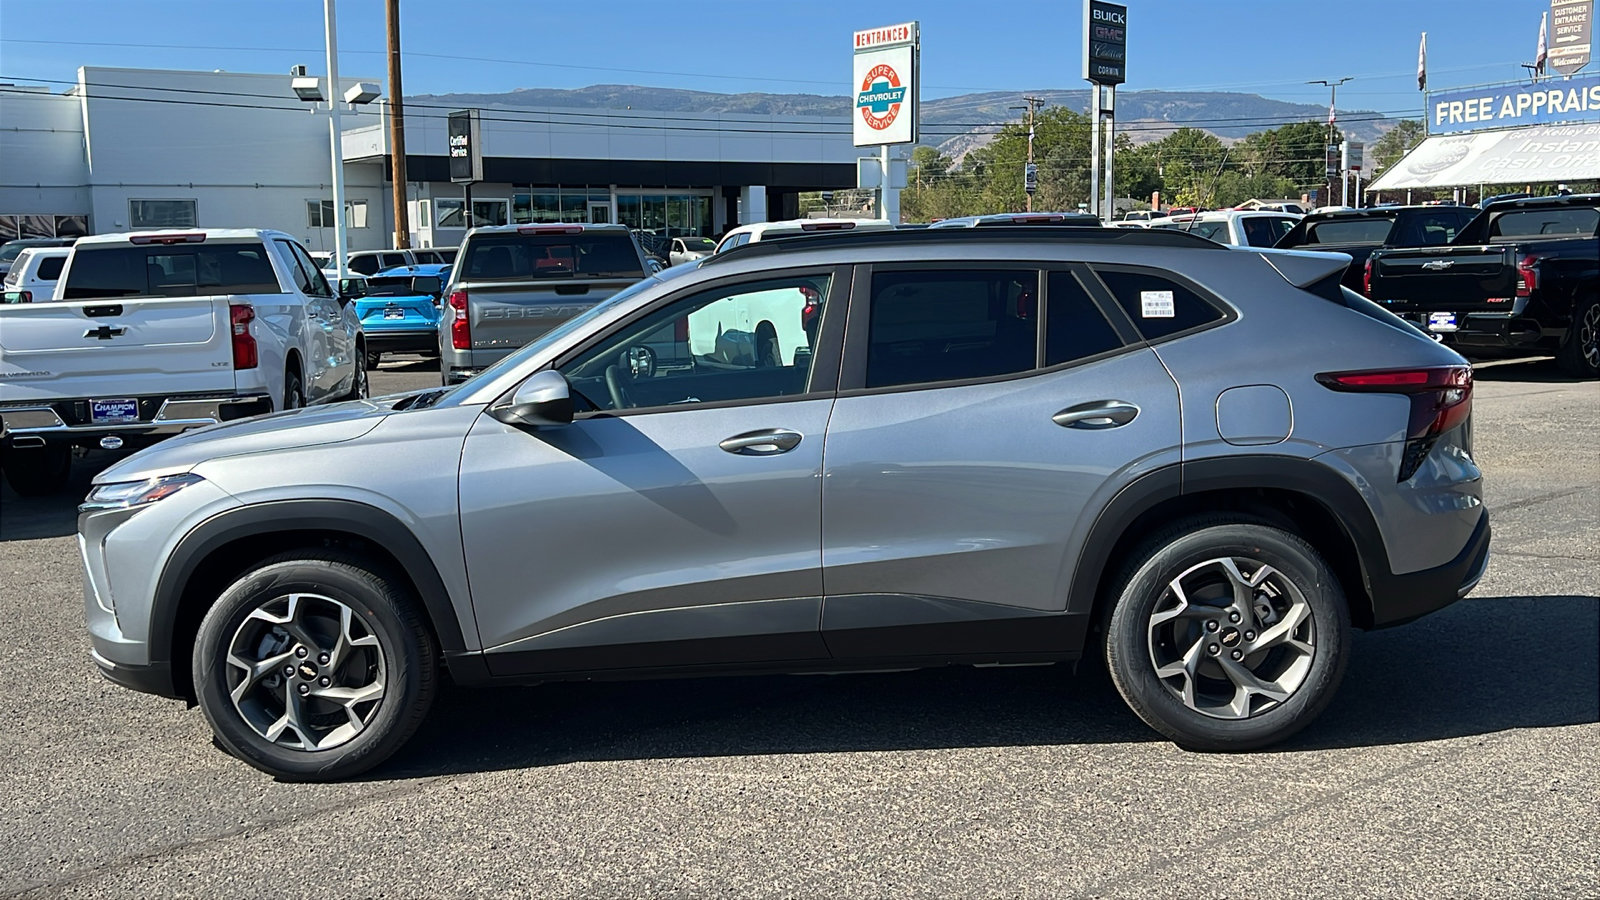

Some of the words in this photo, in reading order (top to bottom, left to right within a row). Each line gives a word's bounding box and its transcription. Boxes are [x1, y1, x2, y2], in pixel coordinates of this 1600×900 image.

[1093, 9, 1125, 24] BUICK
[1554, 5, 1588, 17] CUSTOMER
[1554, 14, 1587, 25] ENTRANCE
[1095, 26, 1123, 40] GMC
[1557, 25, 1583, 35] SERVICE
[861, 27, 902, 46] ENTRANCE
[1552, 55, 1584, 67] Welcome!
[865, 66, 895, 85] SUPER
[859, 91, 902, 104] CHEVROLET
[1436, 97, 1494, 126] FREE
[1498, 85, 1600, 119] APPRAIS
[864, 107, 898, 129] SERVICE
[1541, 127, 1584, 137] Kelley
[449, 135, 468, 146] Certified
[451, 147, 468, 157] Service
[1480, 154, 1545, 170] Cash
[94, 403, 135, 412] CHAMPION
